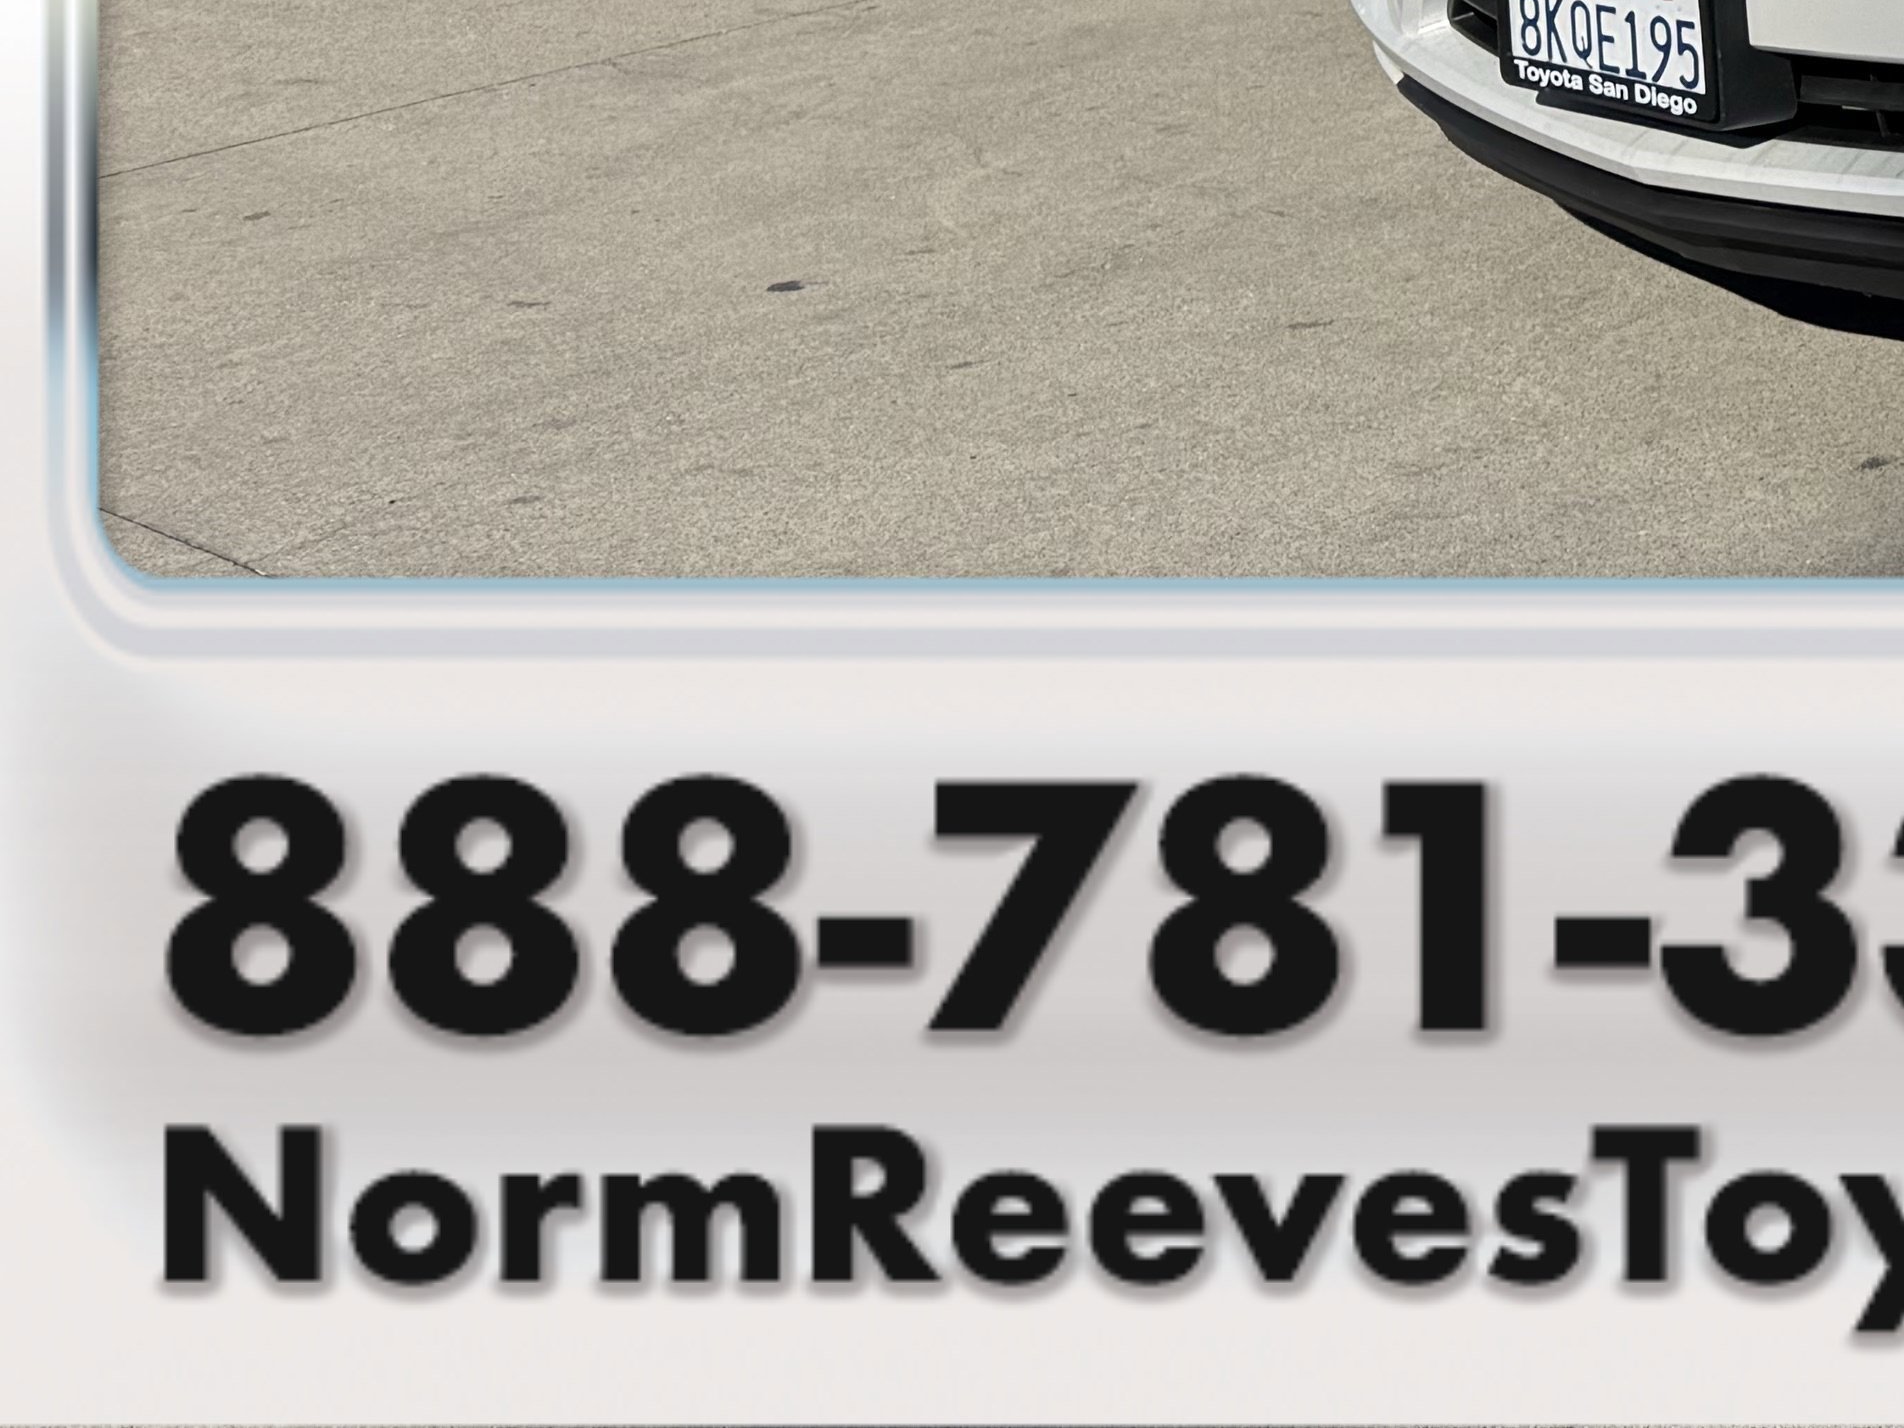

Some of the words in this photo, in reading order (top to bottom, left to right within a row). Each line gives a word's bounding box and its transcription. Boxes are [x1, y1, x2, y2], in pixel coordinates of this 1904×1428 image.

[1513, 58, 1583, 90] Toyota
[1588, 73, 1629, 101] San
[1634, 83, 1698, 115] Diego
